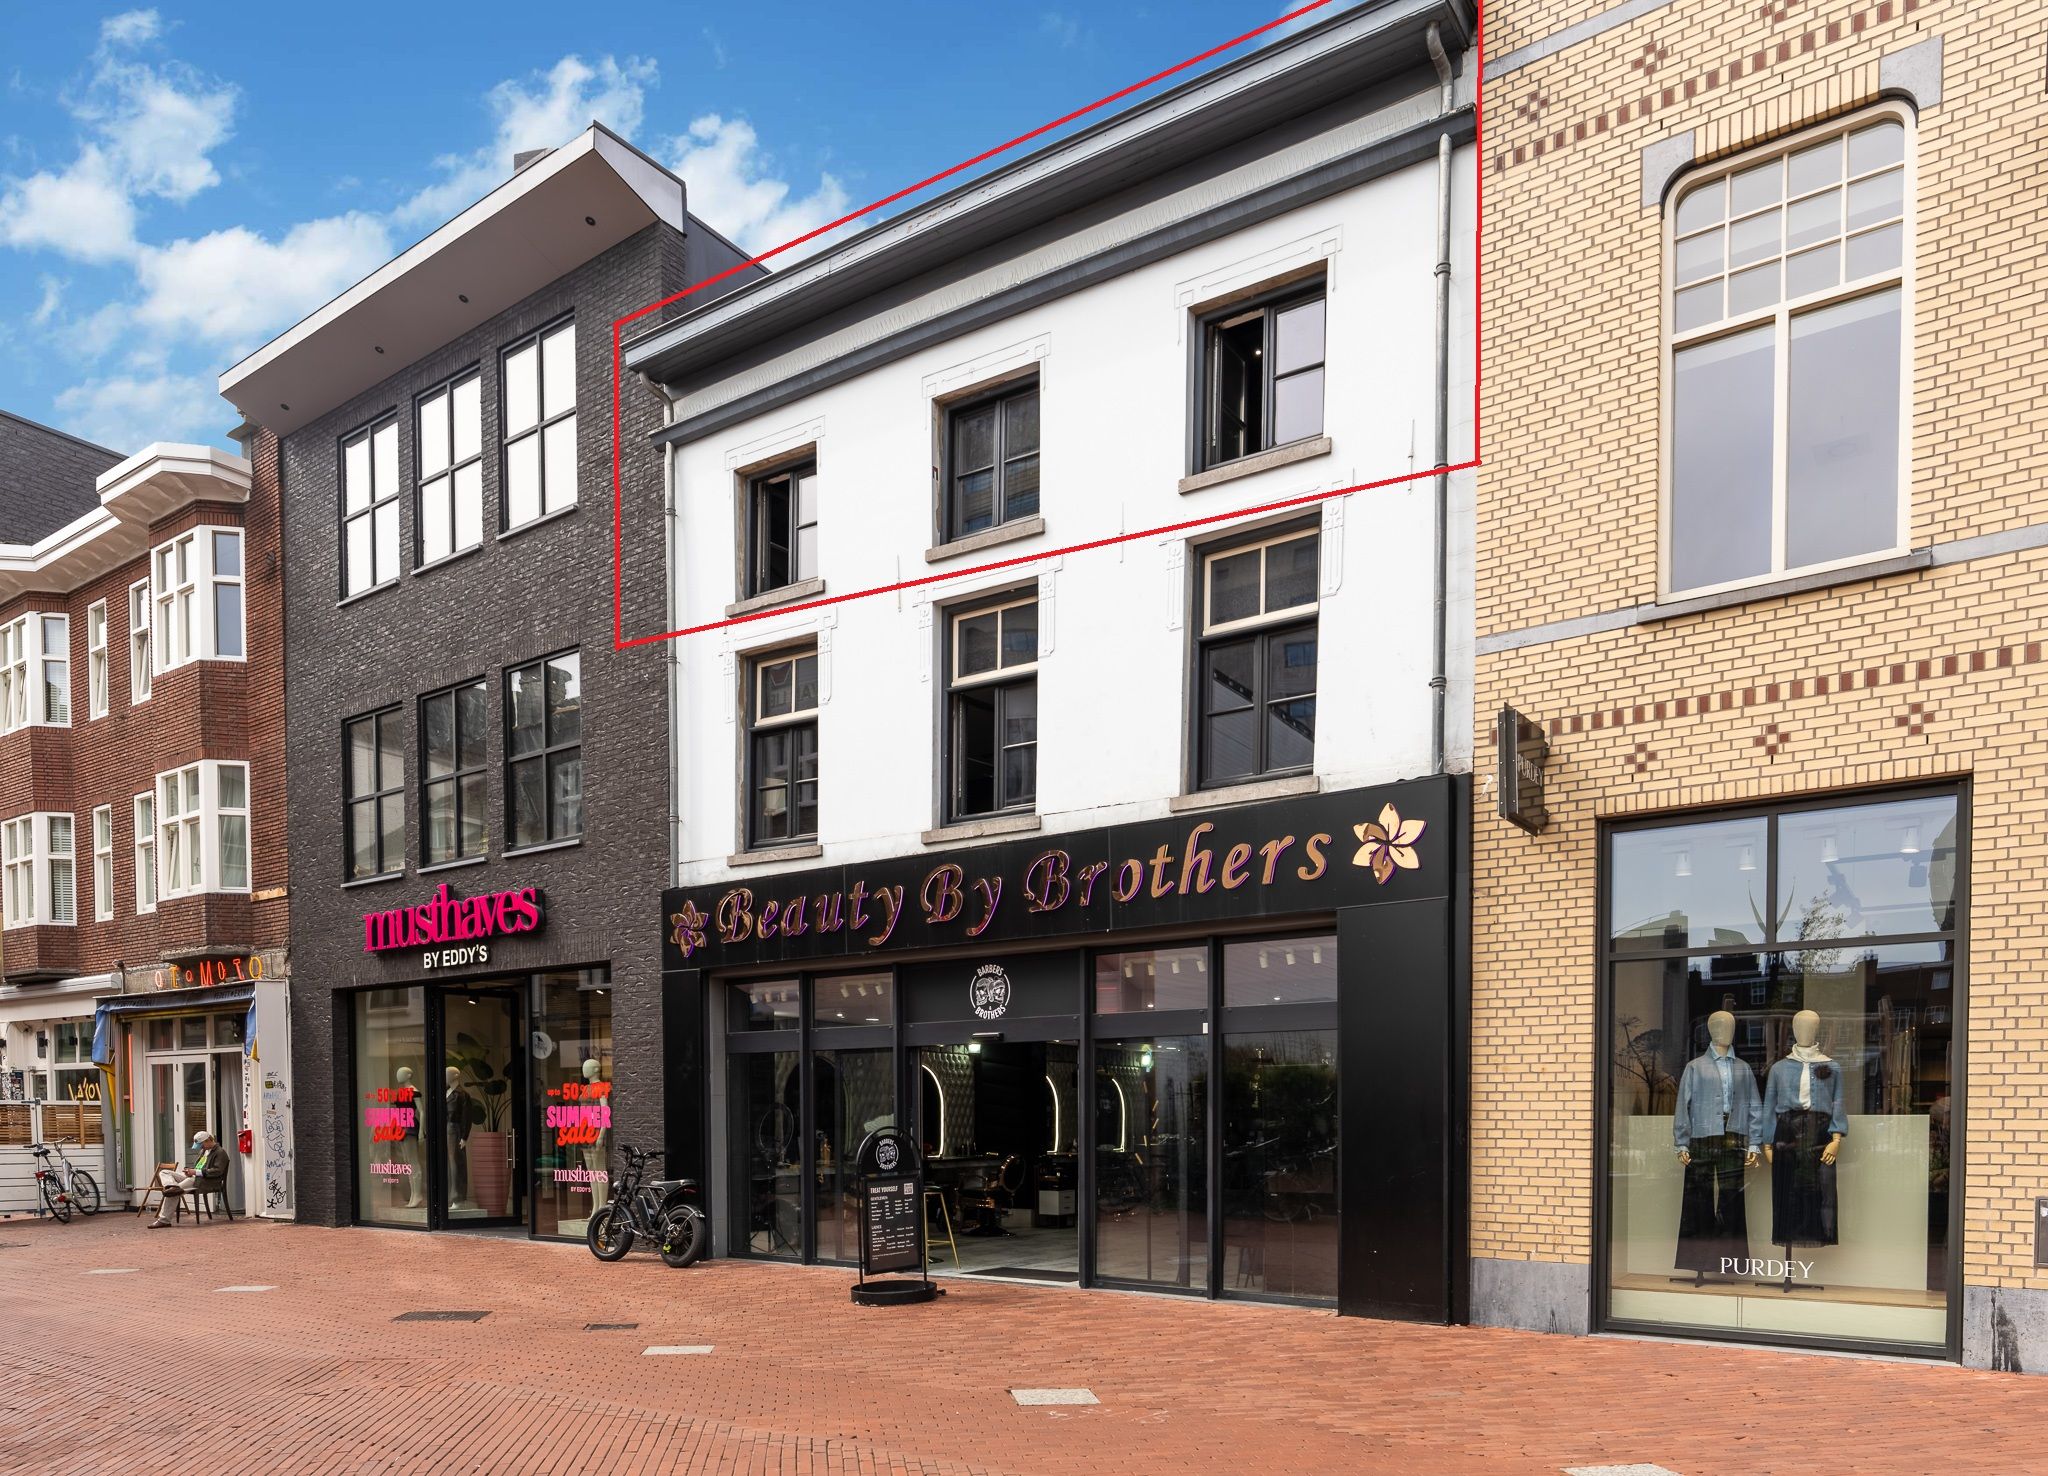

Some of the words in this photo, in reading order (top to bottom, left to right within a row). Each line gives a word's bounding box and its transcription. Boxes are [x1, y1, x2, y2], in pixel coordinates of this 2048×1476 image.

[1518, 754, 1544, 787] PURDEY
[716, 880, 904, 946] Beauty
[920, 863, 1002, 936] By
[1024, 822, 1332, 913] Brothers
[363, 884, 540, 952] musthaves
[423, 951, 440, 969] BY
[443, 945, 488, 967] EDDY'S
[976, 964, 1004, 977] BARBERS
[975, 1004, 1007, 1020] BROTHERS
[398, 1087, 415, 1103] OFF
[590, 1082, 611, 1100] OFF
[365, 1107, 415, 1128] SUMMER
[546, 1105, 611, 1129] SUMMER
[373, 1118, 406, 1143] sale
[557, 1117, 600, 1147] sale
[370, 1159, 412, 1175] musthaves
[553, 1165, 609, 1183] musthaves
[1720, 1257, 1815, 1279] PURDEY
